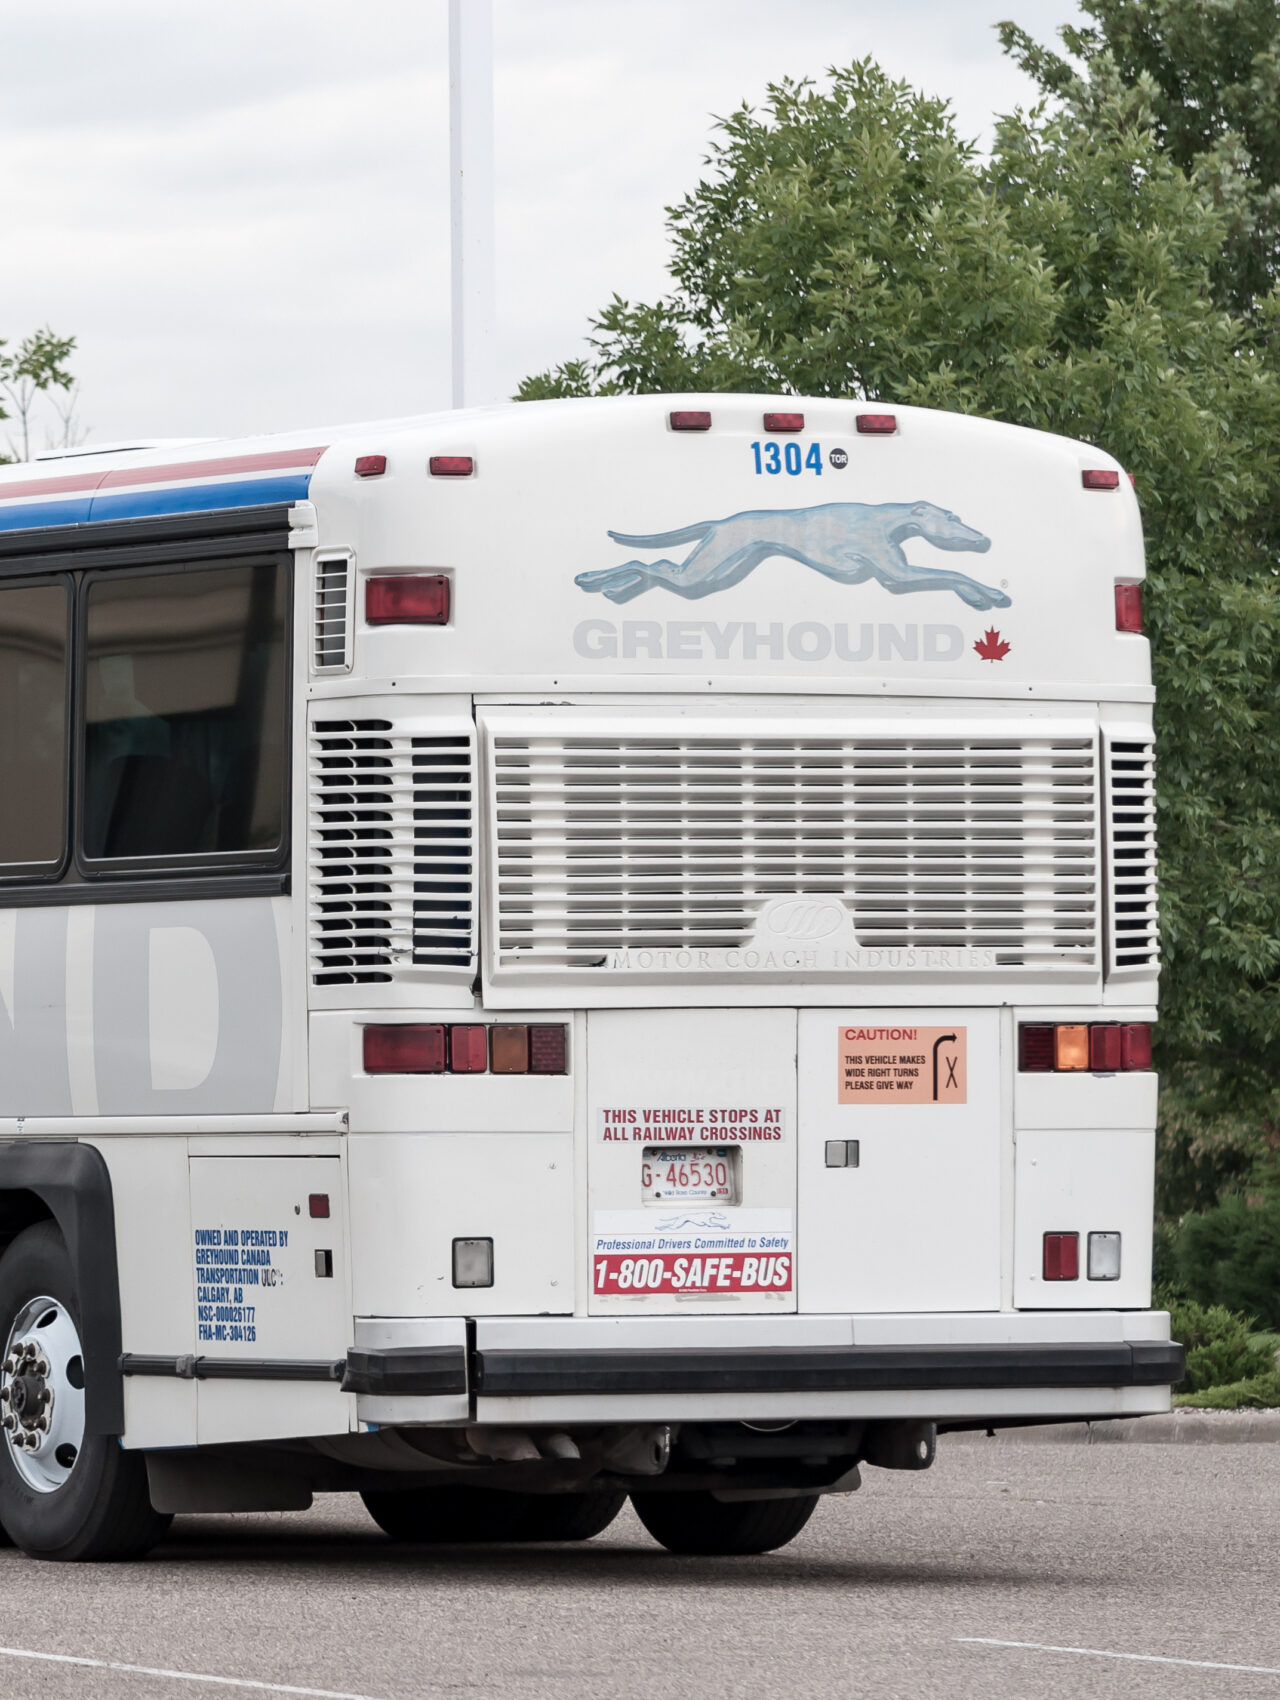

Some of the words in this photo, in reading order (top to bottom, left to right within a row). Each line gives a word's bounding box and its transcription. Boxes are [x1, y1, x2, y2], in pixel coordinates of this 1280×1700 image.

[750, 441, 823, 476] 1304
[830, 454, 847, 463] TOR
[572, 618, 965, 662] GREYHOUND
[612, 950, 710, 969] MOTOR
[724, 950, 819, 968] COACH
[833, 949, 997, 968] INDUSTRIES
[844, 1028, 918, 1041] CAUTION!
[844, 1055, 863, 1065] THIS
[864, 1055, 897, 1065] VEHICLE
[899, 1055, 926, 1065] MAKES
[844, 1068, 866, 1077] WIDE
[867, 1067, 891, 1077] RIGHT
[893, 1067, 919, 1077] TURNS
[845, 1080, 875, 1090] PLEASE
[876, 1080, 895, 1090] GIVE
[896, 1080, 914, 1090] WAY
[603, 1109, 637, 1124] THIS
[642, 1109, 705, 1124] VEHICLE
[708, 1109, 759, 1123] STOPS
[763, 1109, 782, 1123] AT
[602, 1127, 629, 1141] ALL
[632, 1126, 695, 1141] RAILWAY
[700, 1126, 782, 1140] CROSSINGS
[195, 1230, 221, 1246] OWNED
[223, 1230, 239, 1246] AND
[240, 1230, 277, 1247] OPERATED
[279, 1231, 289, 1247] BY
[596, 1239, 656, 1250] Professional
[657, 1238, 692, 1249] Drivers
[694, 1238, 746, 1249] Committed
[747, 1238, 757, 1248] to
[759, 1237, 789, 1249] Safety
[195, 1249, 239, 1265] GREYHOUND
[241, 1249, 271, 1266] CANADA
[196, 1268, 259, 1285] TRANSPORTATION
[595, 1256, 790, 1289] 1-800-SAFE-BUS
[197, 1286, 232, 1304] CALGARY,
[233, 1287, 244, 1303] AB
